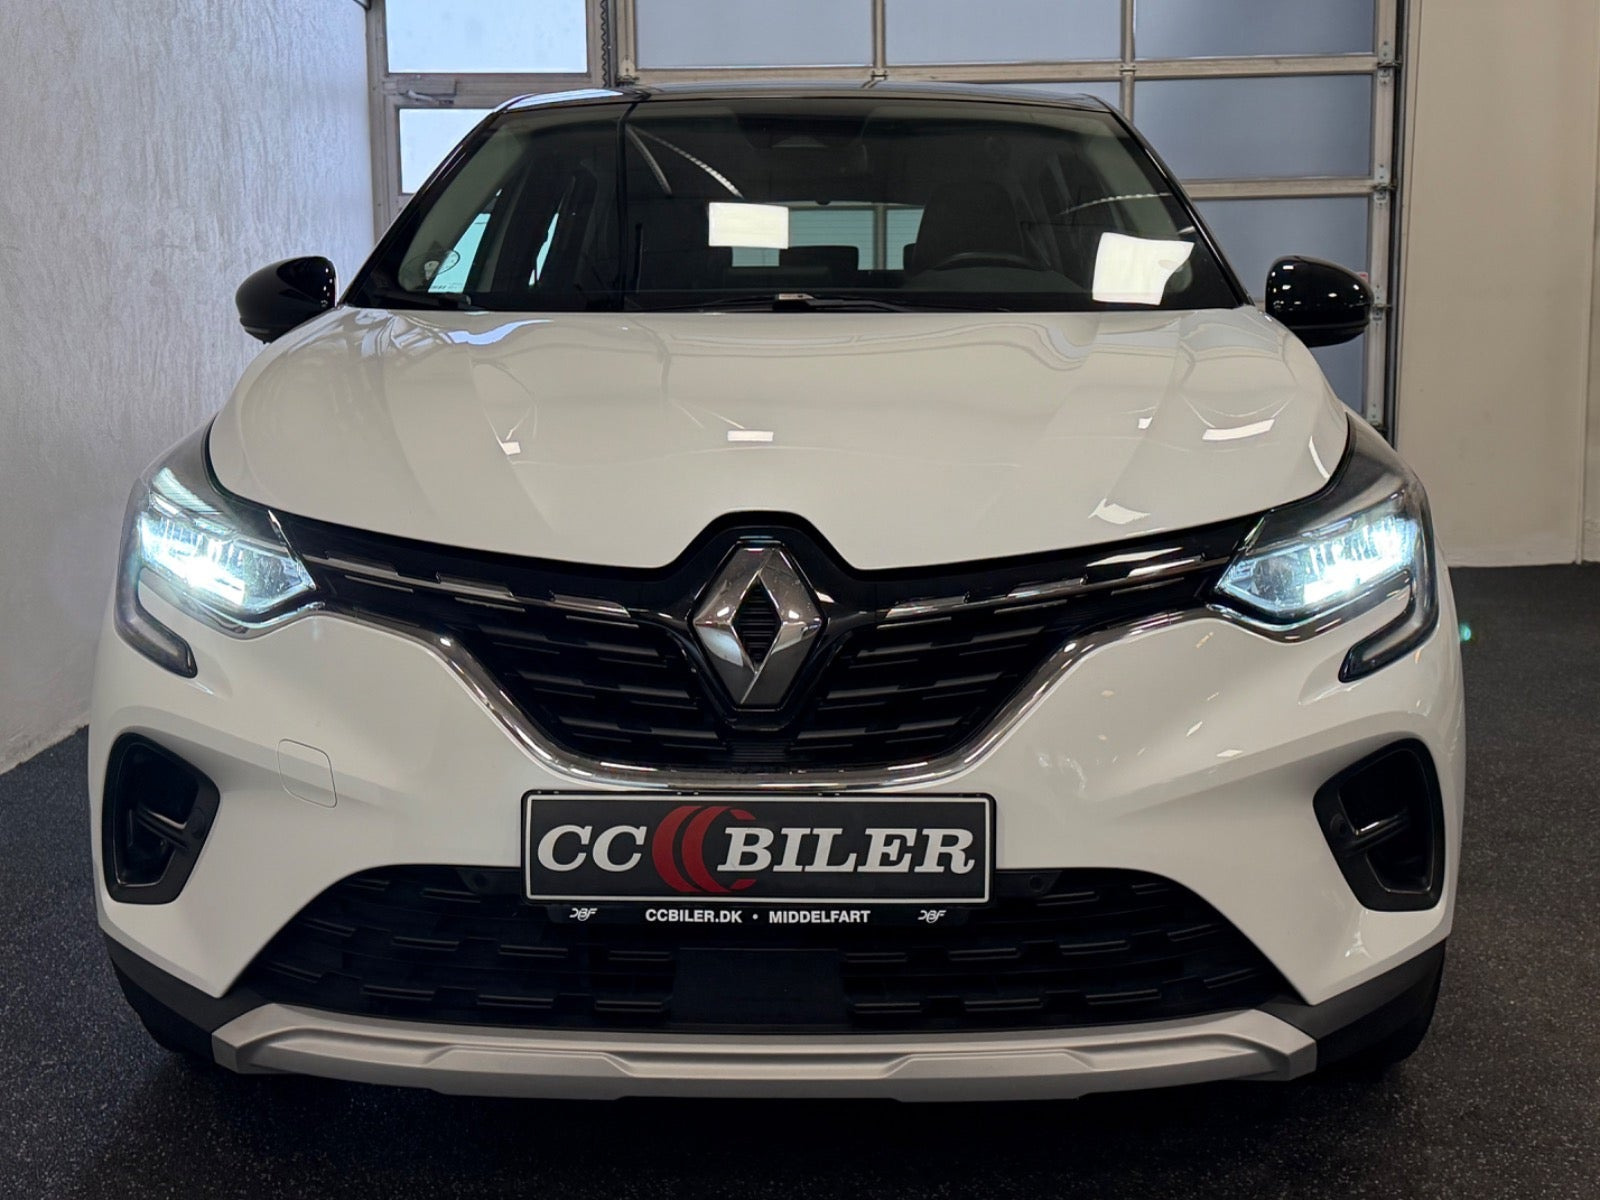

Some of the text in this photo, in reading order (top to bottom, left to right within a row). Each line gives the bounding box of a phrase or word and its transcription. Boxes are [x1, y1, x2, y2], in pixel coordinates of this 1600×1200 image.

[716, 826, 976, 875] BILER
[645, 908, 871, 924] CCBILER.DK MIDDELFART
